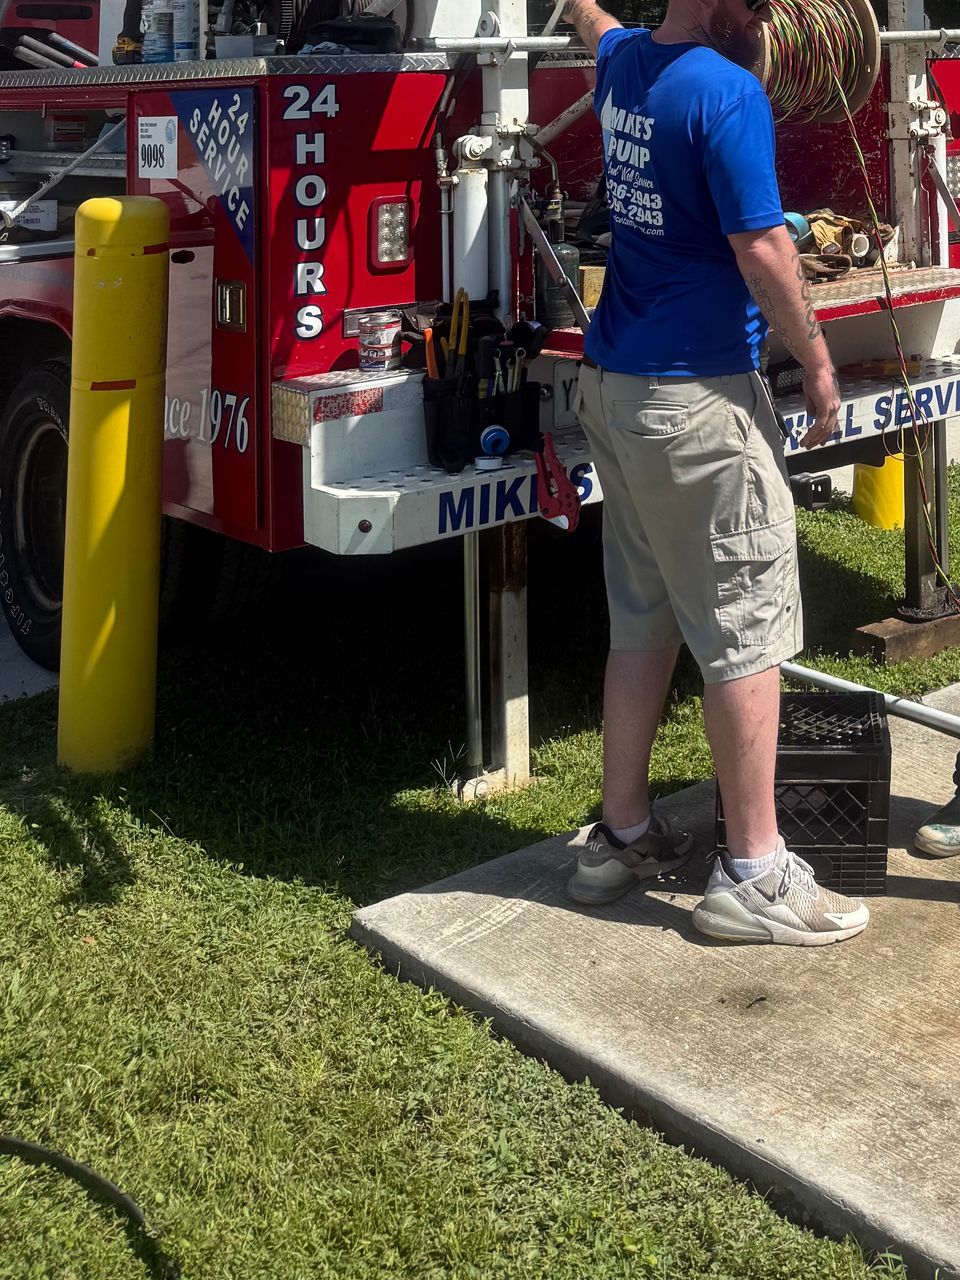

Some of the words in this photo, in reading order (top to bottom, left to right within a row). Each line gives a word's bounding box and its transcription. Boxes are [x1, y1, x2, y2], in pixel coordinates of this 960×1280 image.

[228, 93, 249, 135] 24
[283, 84, 340, 120] 24
[141, 143, 165, 169] 9098
[189, 107, 250, 231] SERVICE
[208, 98, 249, 185] HOUR
[295, 132, 327, 339] HOURS
[197, 387, 250, 454] 1976
[438, 463, 594, 535] MIKS
